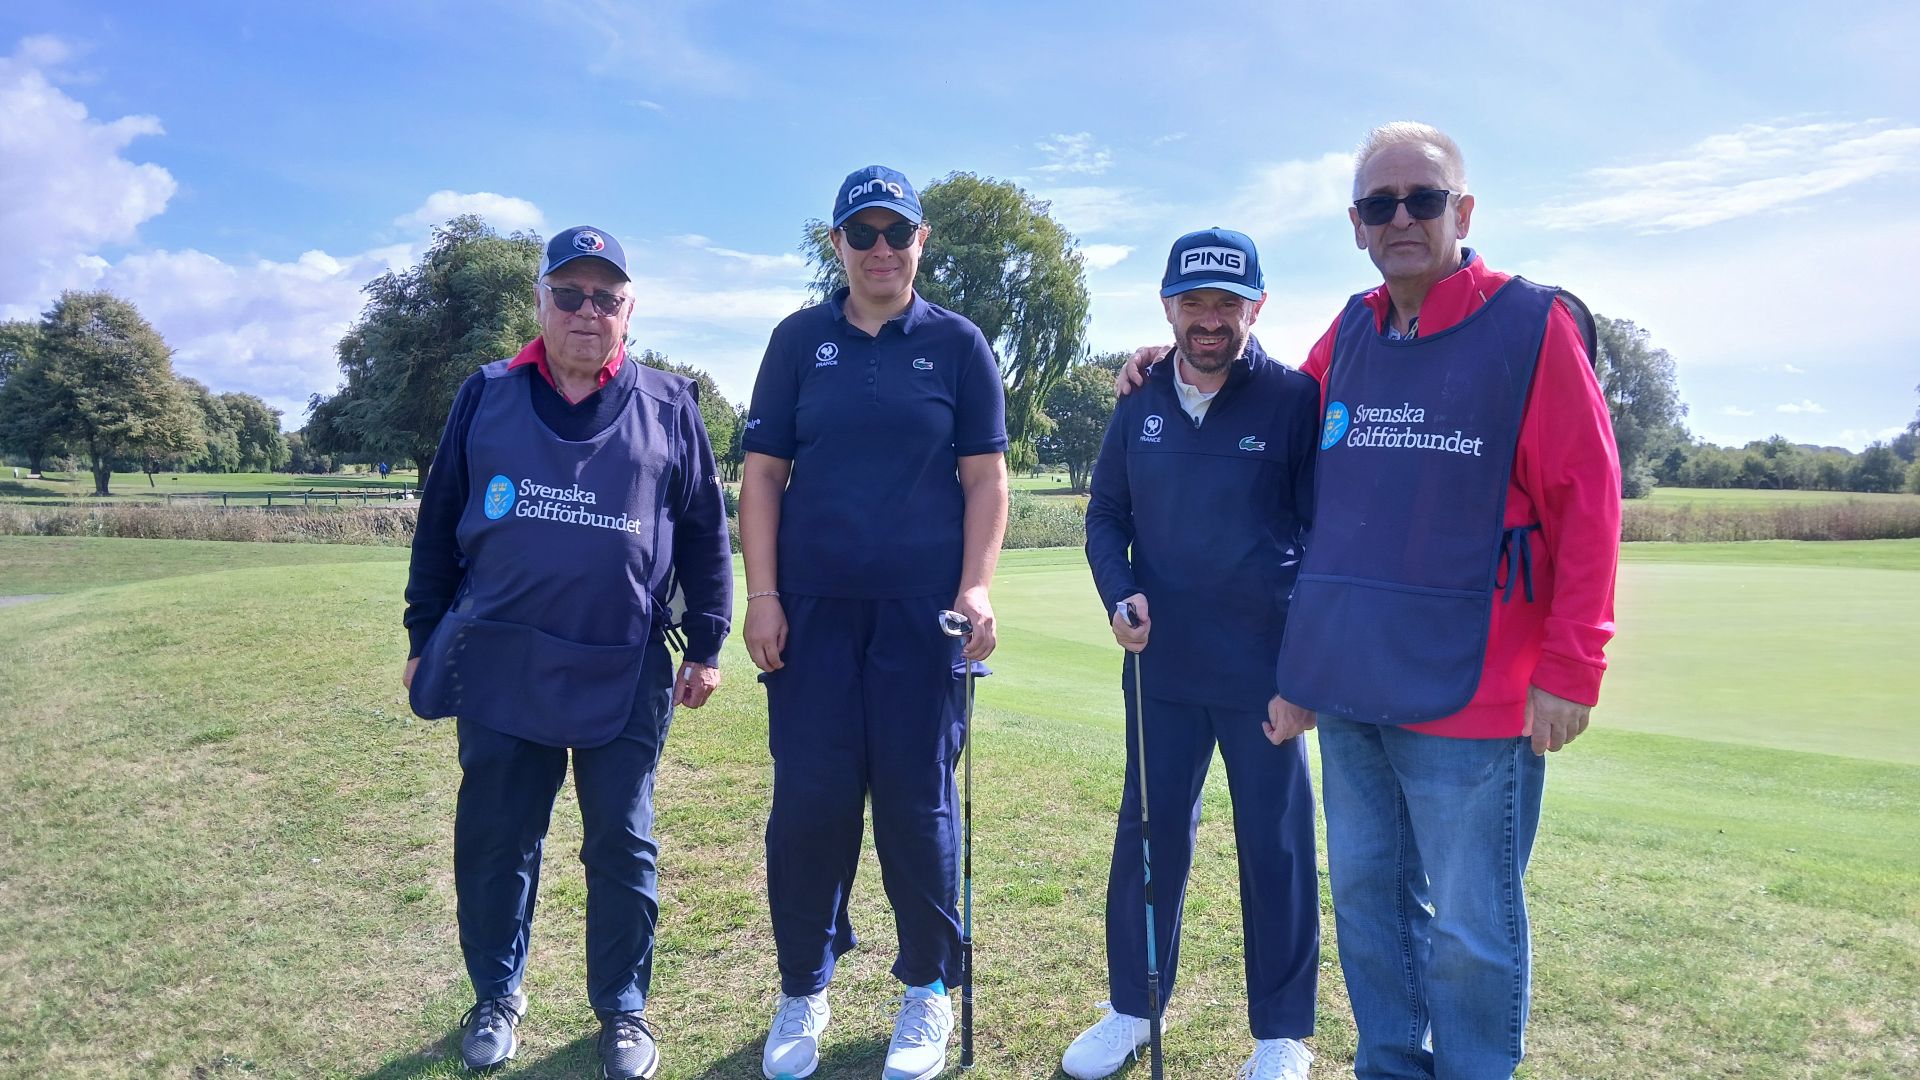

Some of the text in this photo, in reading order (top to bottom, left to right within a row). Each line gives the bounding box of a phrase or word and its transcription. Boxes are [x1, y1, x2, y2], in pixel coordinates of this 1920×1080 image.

[848, 179, 904, 205] ping
[1185, 252, 1241, 269] PING
[1353, 402, 1425, 424] Svenska
[1347, 426, 1483, 457] Golfförbundet
[518, 478, 597, 505] Svenska
[515, 500, 642, 534] Golfförbundet
